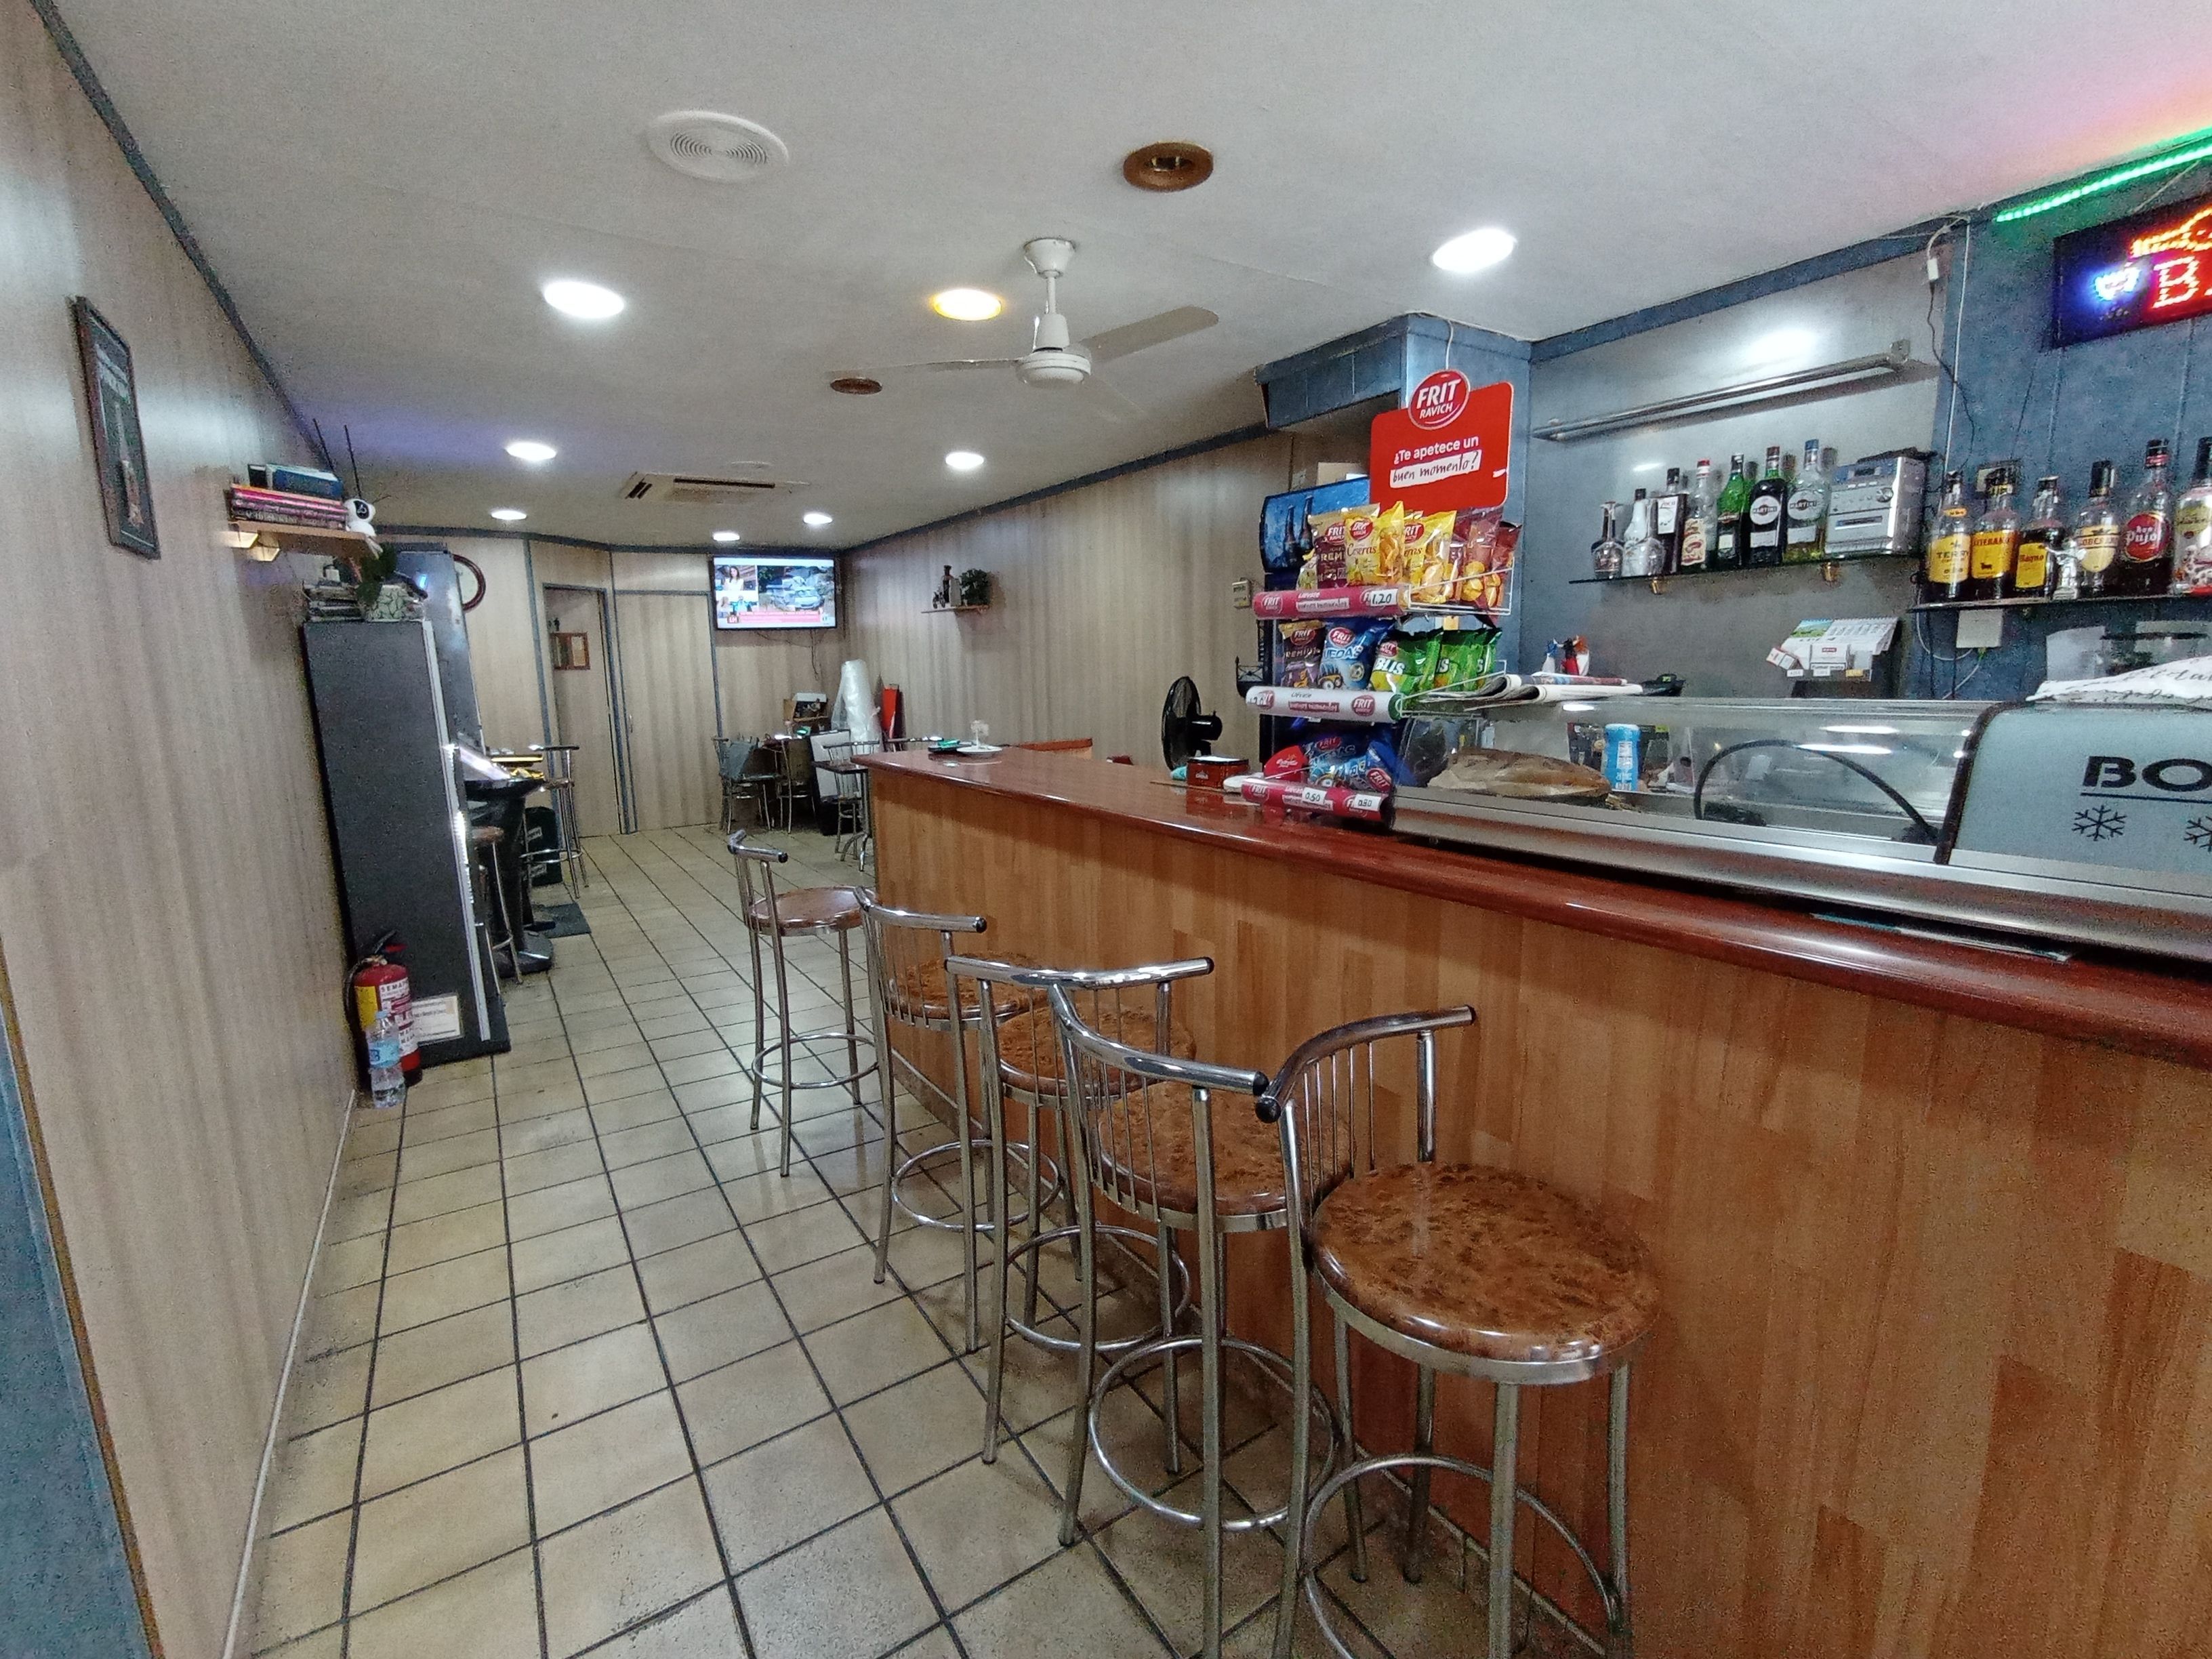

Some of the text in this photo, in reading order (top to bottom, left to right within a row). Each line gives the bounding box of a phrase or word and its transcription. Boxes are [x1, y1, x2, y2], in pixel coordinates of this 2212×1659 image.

[2152, 256, 2212, 309] B
[1416, 378, 1462, 409] FRIT
[1419, 402, 1454, 419] RAVICH
[1393, 436, 1479, 464] ¿Te apetece un
[1393, 451, 1479, 484] buen momento?
[1404, 525, 1422, 536] RIT
[1263, 596, 1280, 606] FRIT
[1332, 630, 1352, 641] FRIT
[1353, 698, 1374, 709] FRIT
[1370, 771, 1391, 791] FRIT
